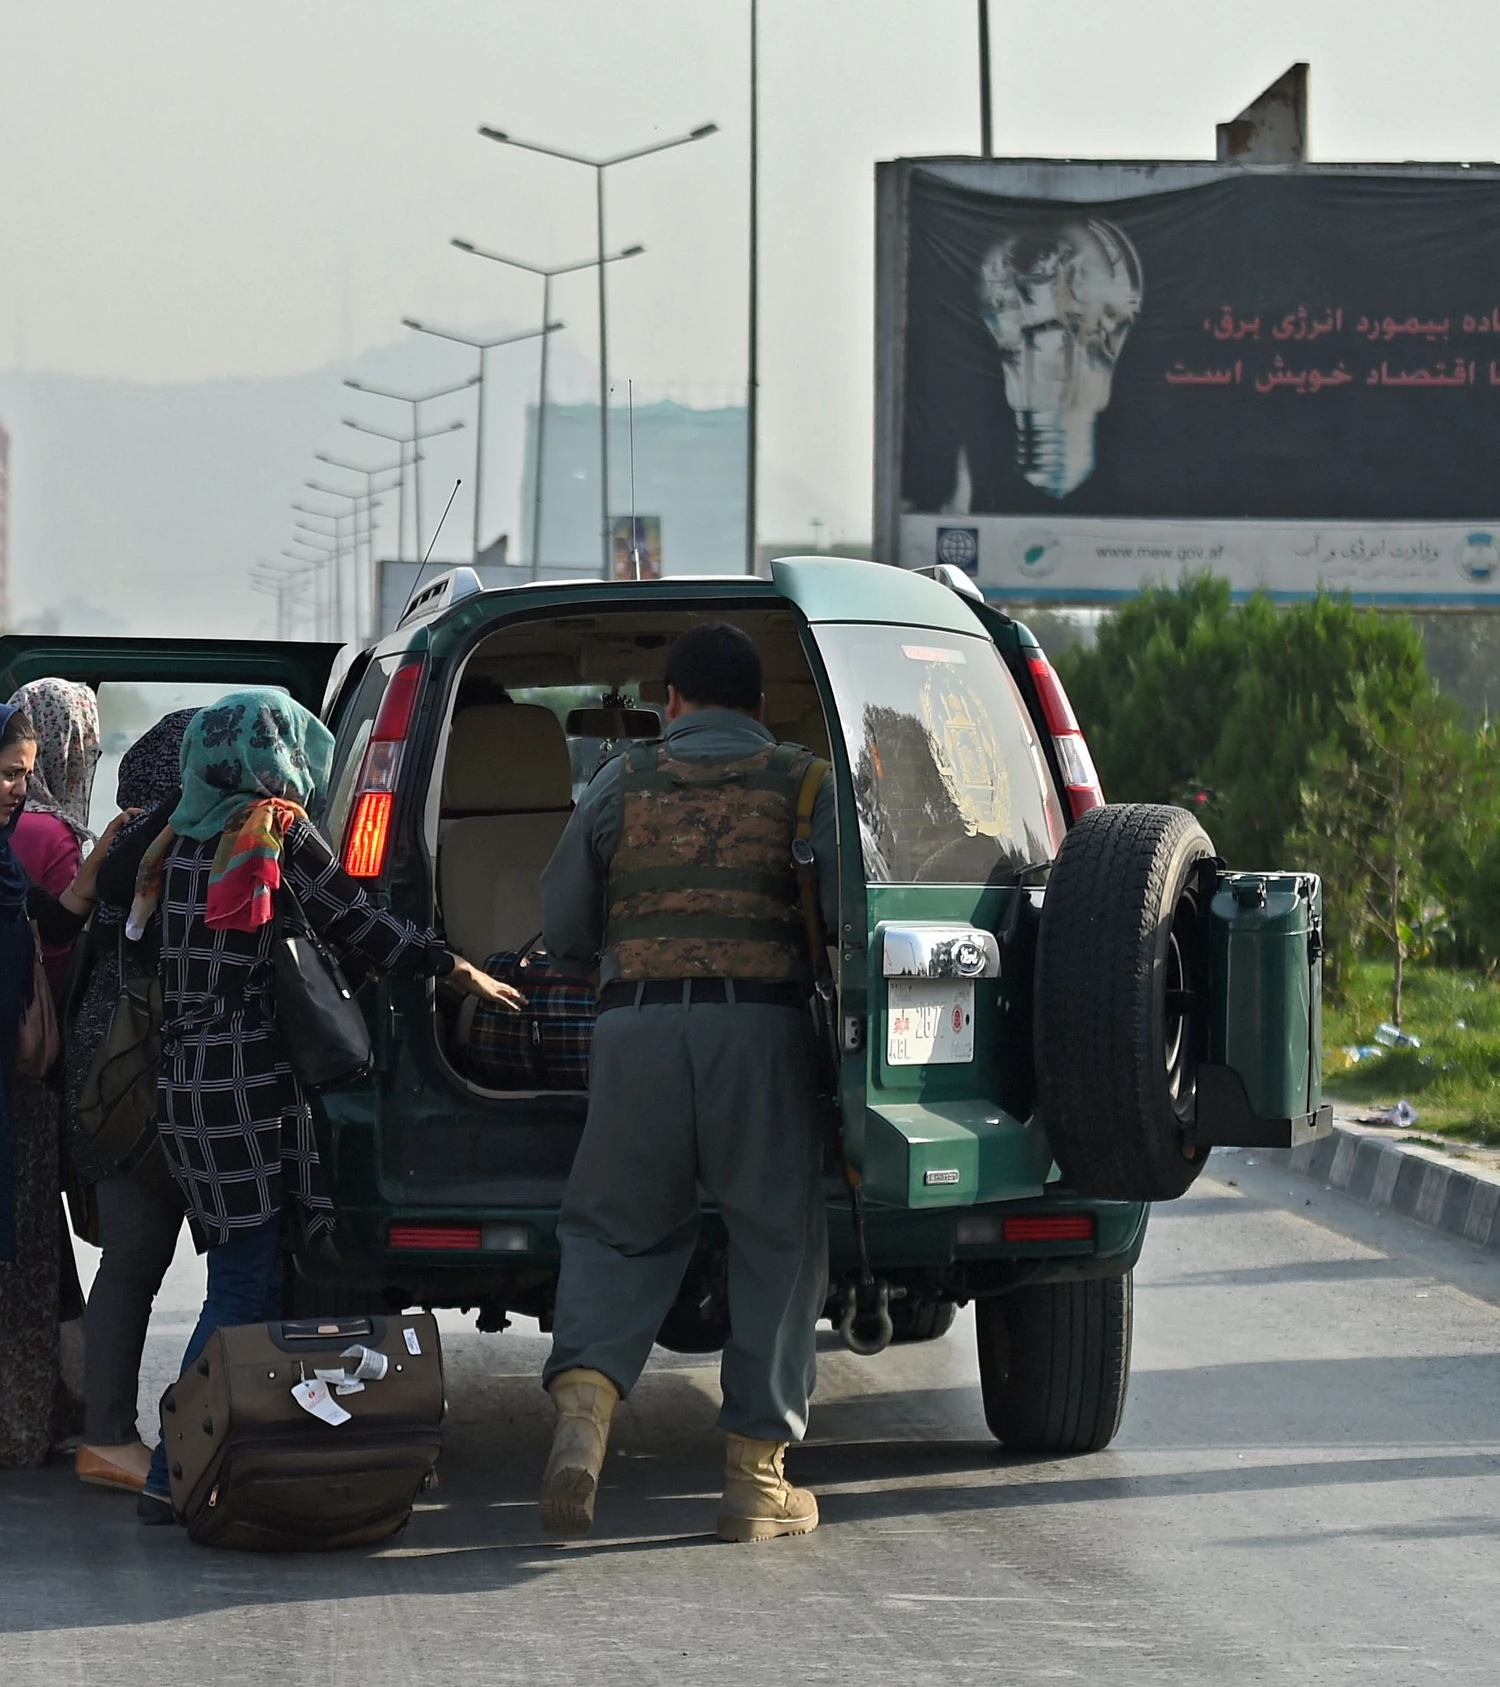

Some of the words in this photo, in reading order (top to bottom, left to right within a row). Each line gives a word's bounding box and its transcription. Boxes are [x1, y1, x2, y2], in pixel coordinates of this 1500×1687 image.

[1272, 304, 1342, 341] انرژی
[1356, 313, 1449, 341] بیمورد
[1165, 360, 1242, 384] است
[1255, 354, 1353, 393] خویش
[1367, 358, 1476, 386] اقتصاد
[1095, 546, 1225, 563] www.mew.gov.af
